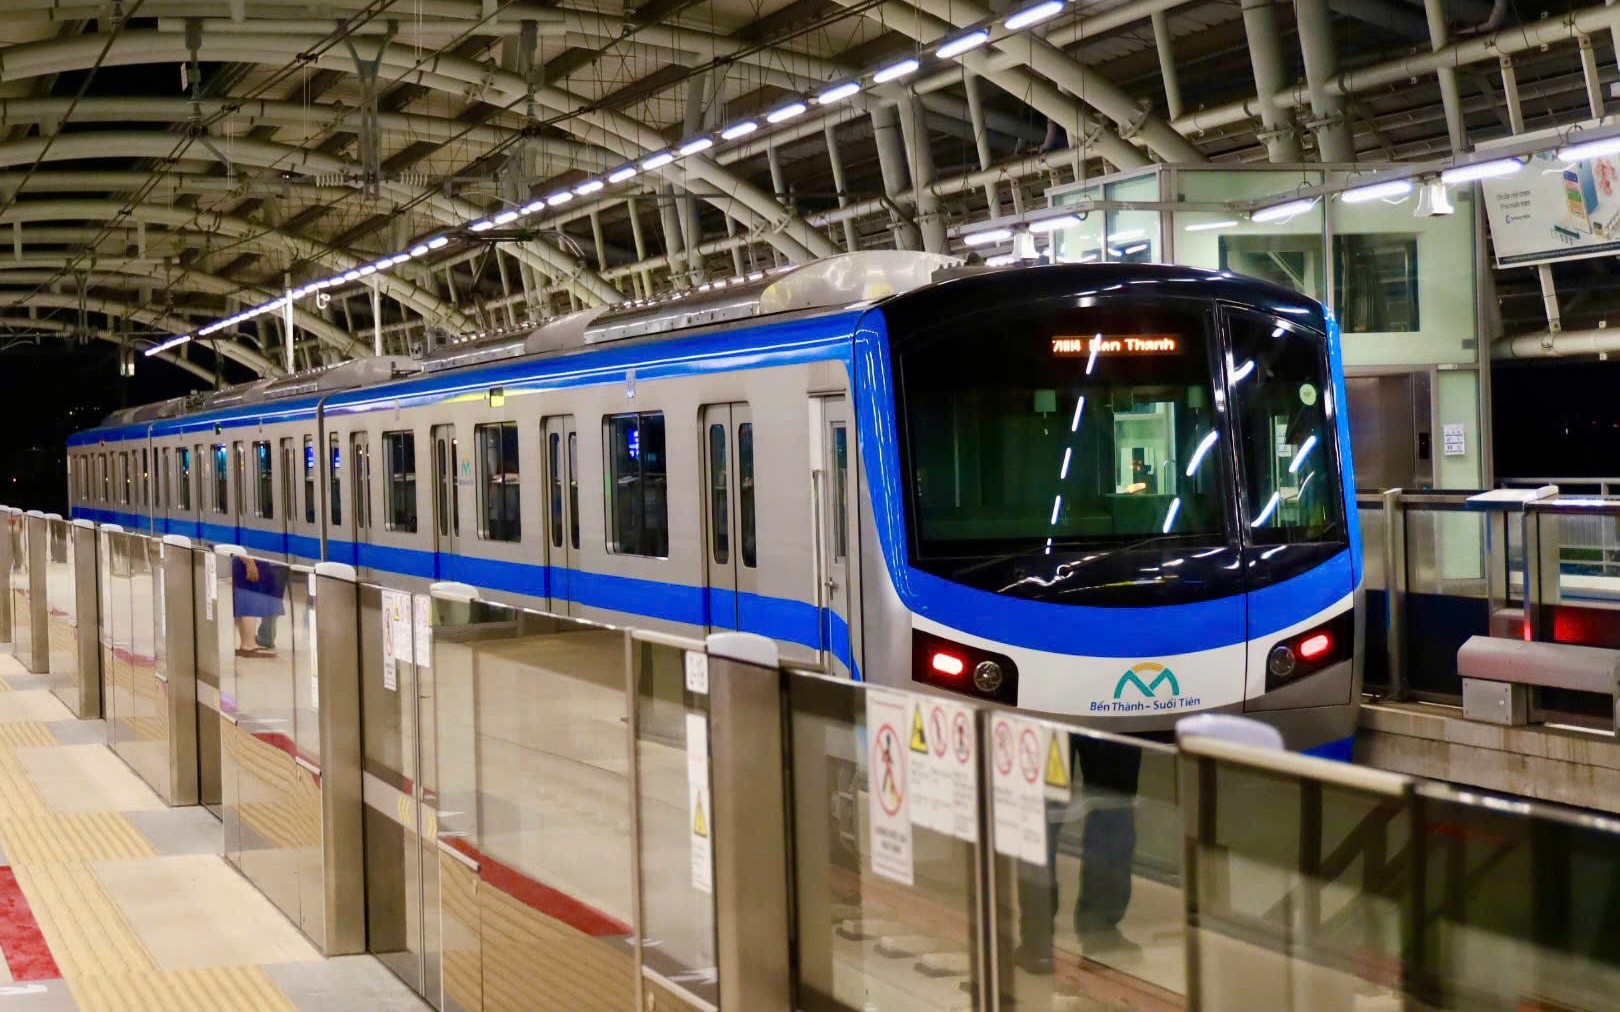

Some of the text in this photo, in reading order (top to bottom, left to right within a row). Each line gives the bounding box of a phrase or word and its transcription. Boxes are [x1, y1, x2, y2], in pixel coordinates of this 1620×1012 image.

[1124, 338, 1175, 351] Thanh
[1090, 700, 1110, 711] Bến
[1112, 700, 1144, 711] Thành
